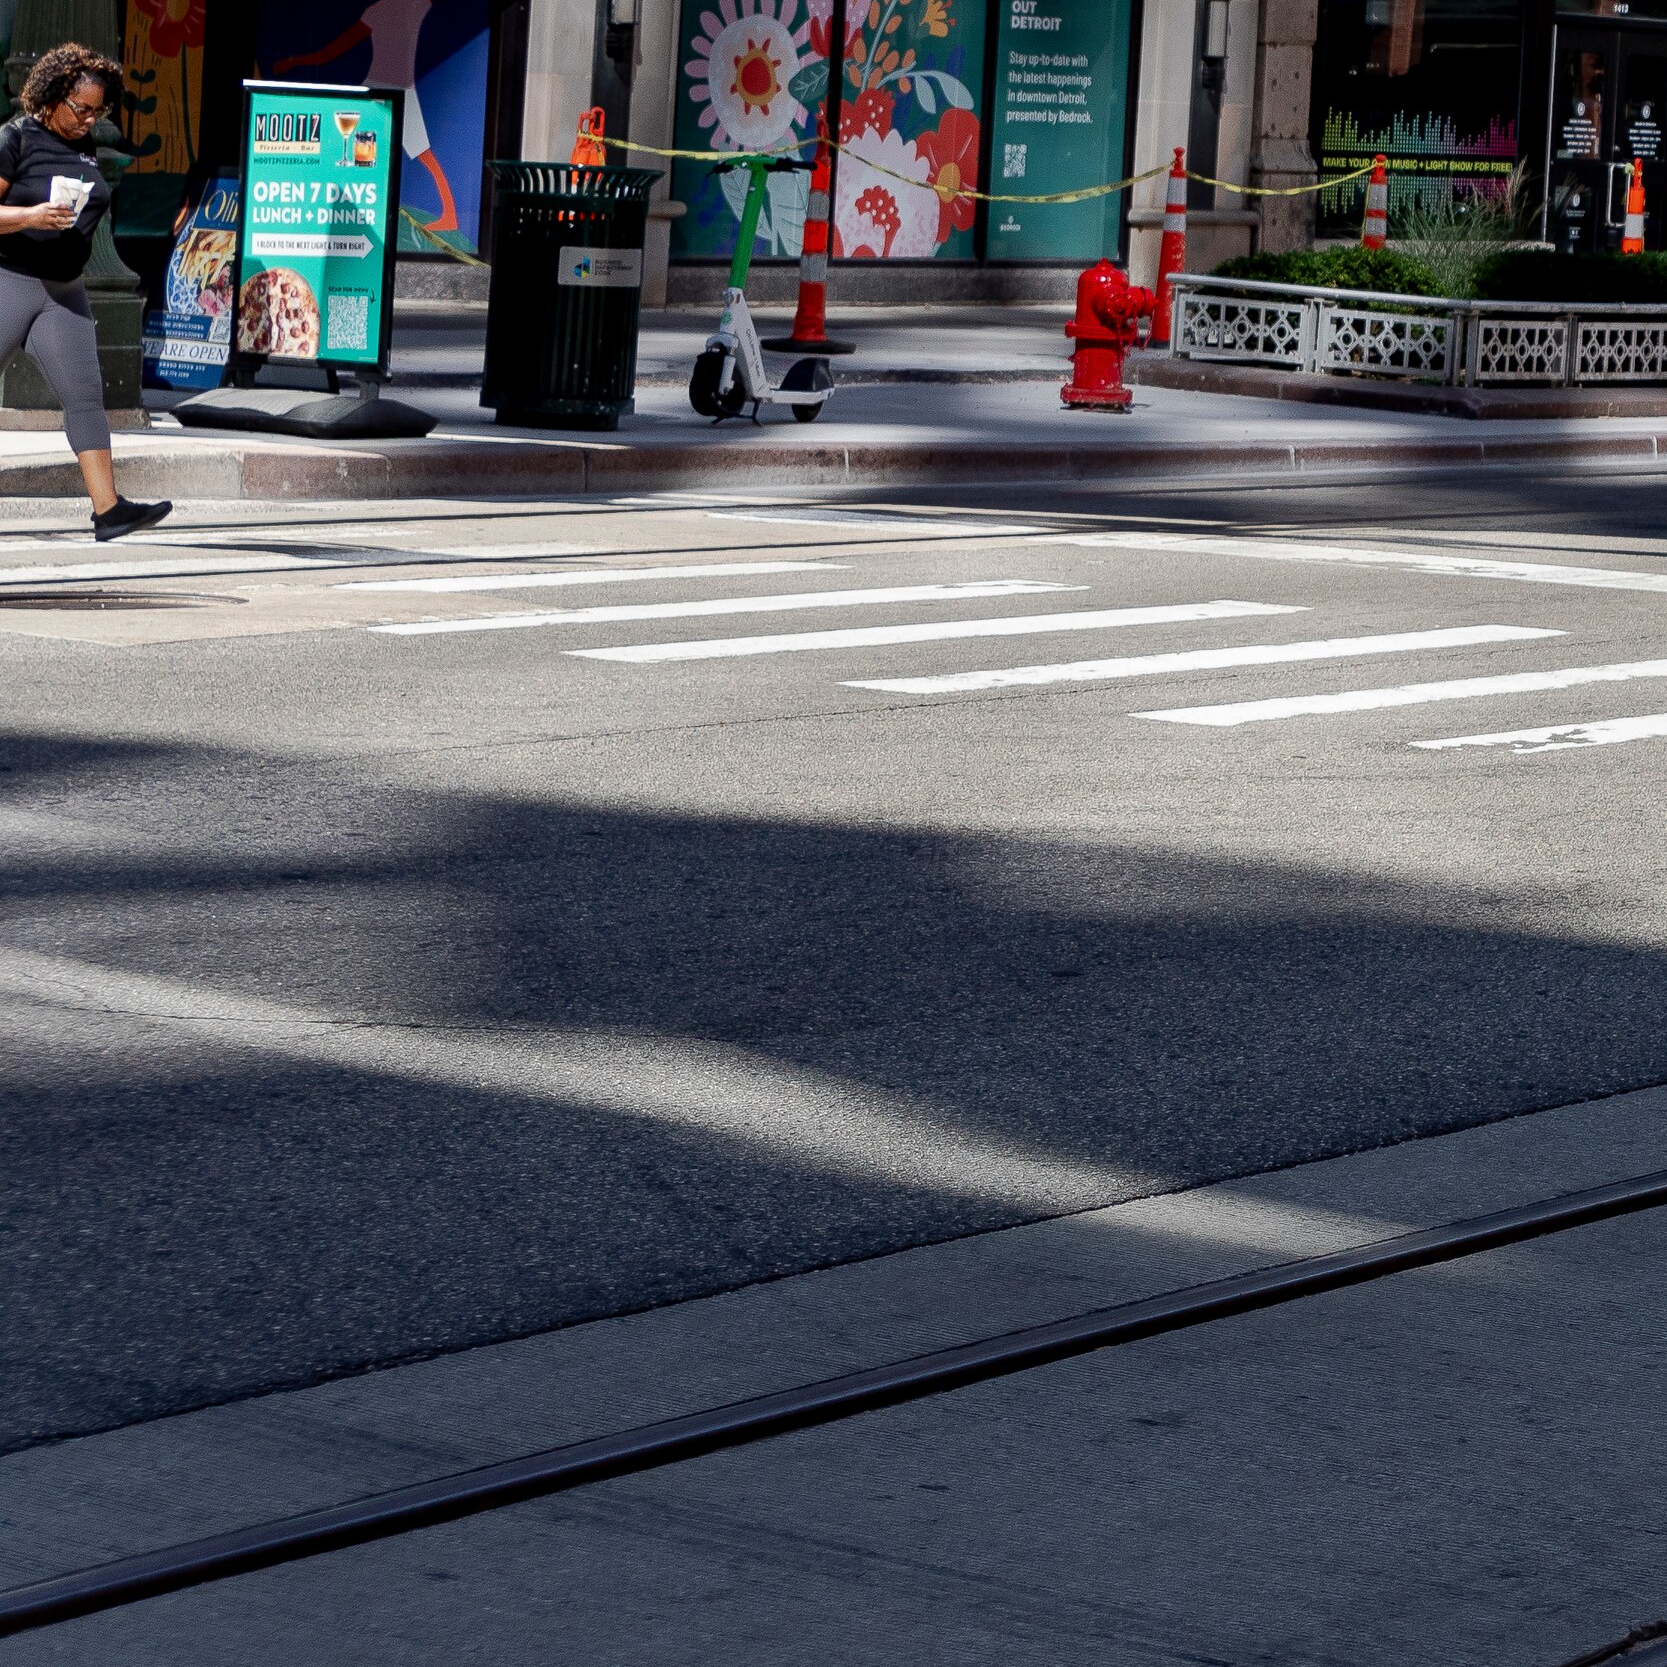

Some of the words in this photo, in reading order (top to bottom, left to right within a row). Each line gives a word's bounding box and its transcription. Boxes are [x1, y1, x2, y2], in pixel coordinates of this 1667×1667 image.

[1011, 0, 1038, 14] OUT
[1010, 15, 1062, 31] DETROIT
[1009, 51, 1028, 68] Stay
[1028, 53, 1070, 68] up-to-date
[1071, 55, 1088, 68] with
[1008, 71, 1023, 84] the
[1023, 71, 1047, 85] latest
[1047, 72, 1092, 89] happenings
[1007, 89, 1016, 102] in
[1016, 89, 1058, 104] downtown
[1006, 109, 1047, 124] presented
[1048, 110, 1058, 125] by
[255, 113, 321, 142] MOOTZ
[1322, 156, 1347, 168] MAKE
[1348, 157, 1370, 168] YOUR
[1371, 159, 1391, 169] ON
[1392, 159, 1418, 170] MUSIC
[1425, 160, 1449, 171] LIGHT
[1449, 161, 1473, 172] SHOW
[1473, 162, 1490, 172] FOR
[253, 181, 305, 203] OPEN
[309, 182, 321, 204] 7
[326, 182, 377, 205] DAYS
[252, 206, 302, 224] LUNCH
[305, 210, 314, 223] +
[317, 208, 376, 226] DINNER
[260, 239, 276, 249] BLOCK
[286, 239, 295, 249] THE
[296, 240, 310, 249] NEXT
[311, 240, 327, 250] LIGHT
[333, 240, 348, 251] TURN
[349, 241, 365, 251] RIGHT
[163, 342, 188, 357] ARE
[189, 344, 228, 362] OPEN
